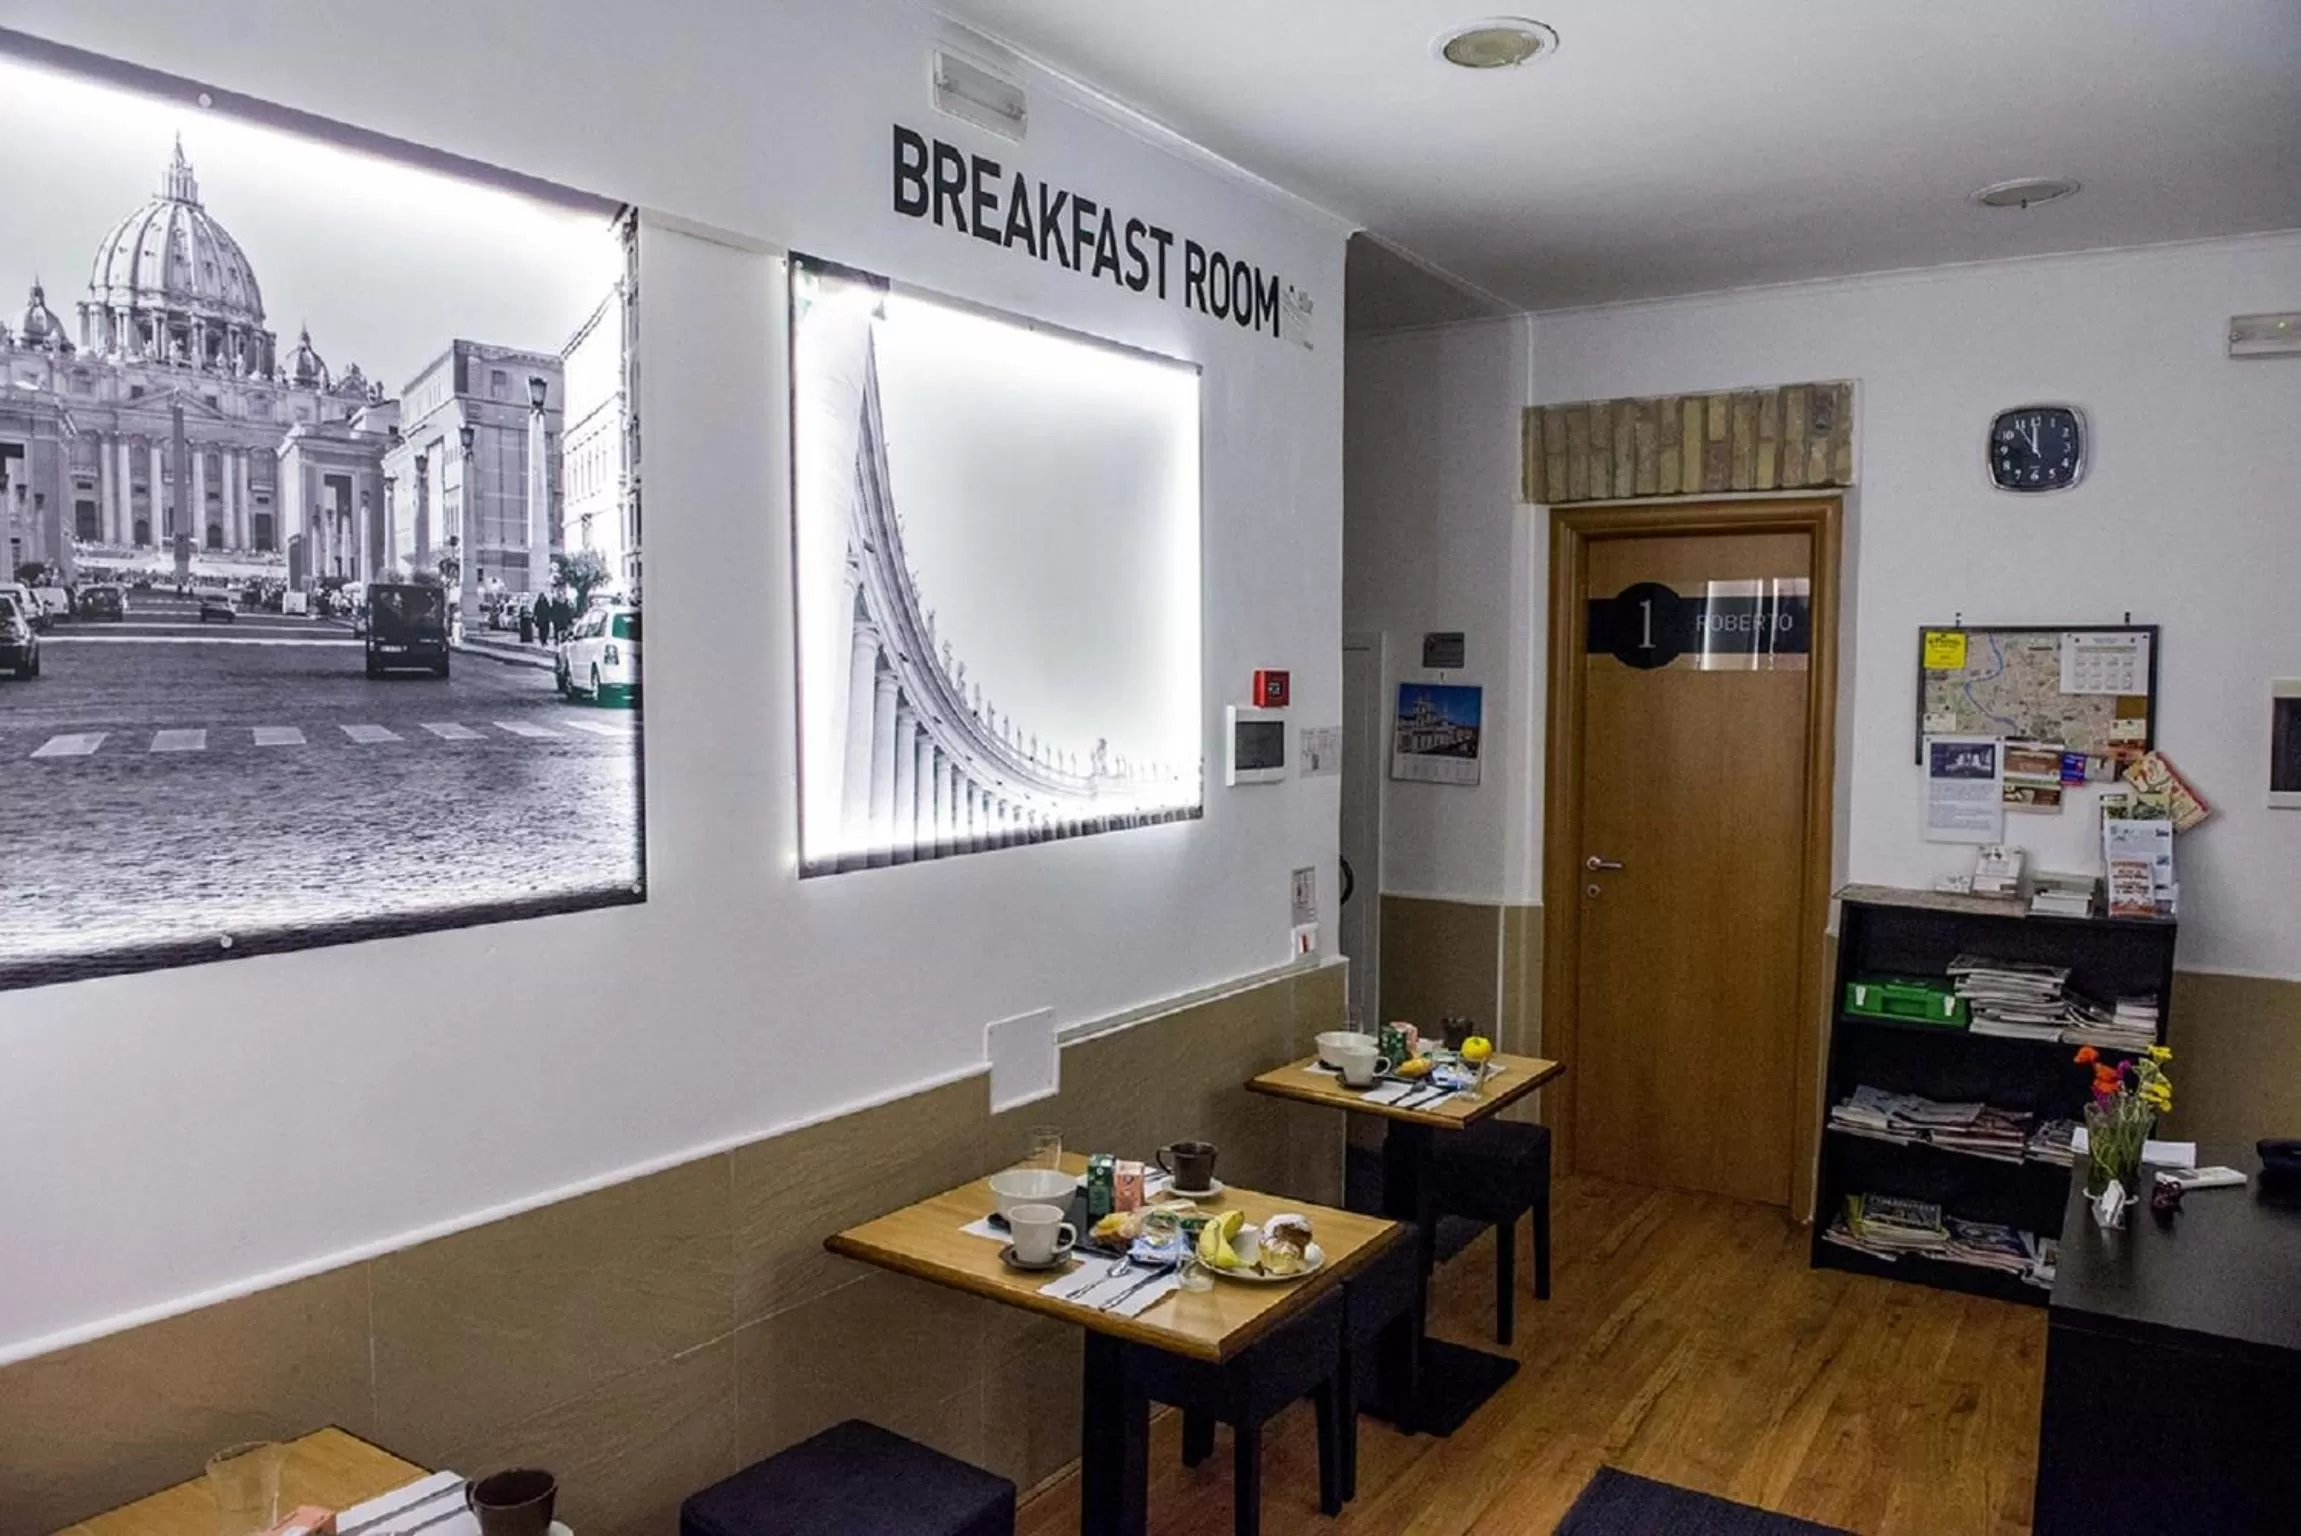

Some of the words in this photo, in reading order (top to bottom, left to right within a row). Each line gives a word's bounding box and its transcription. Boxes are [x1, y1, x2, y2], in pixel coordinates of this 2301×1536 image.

[893, 124, 1173, 299] BREAKFAST
[1185, 240, 1280, 338] ROOM
[2002, 430, 2015, 441] 10
[2062, 427, 2070, 438] 2
[2000, 445, 2009, 455] 9
[2061, 457, 2069, 468] 4
[2030, 469, 2040, 480] 6
[1639, 600, 1656, 649] 1
[1696, 614, 1793, 632] ROBERTO
